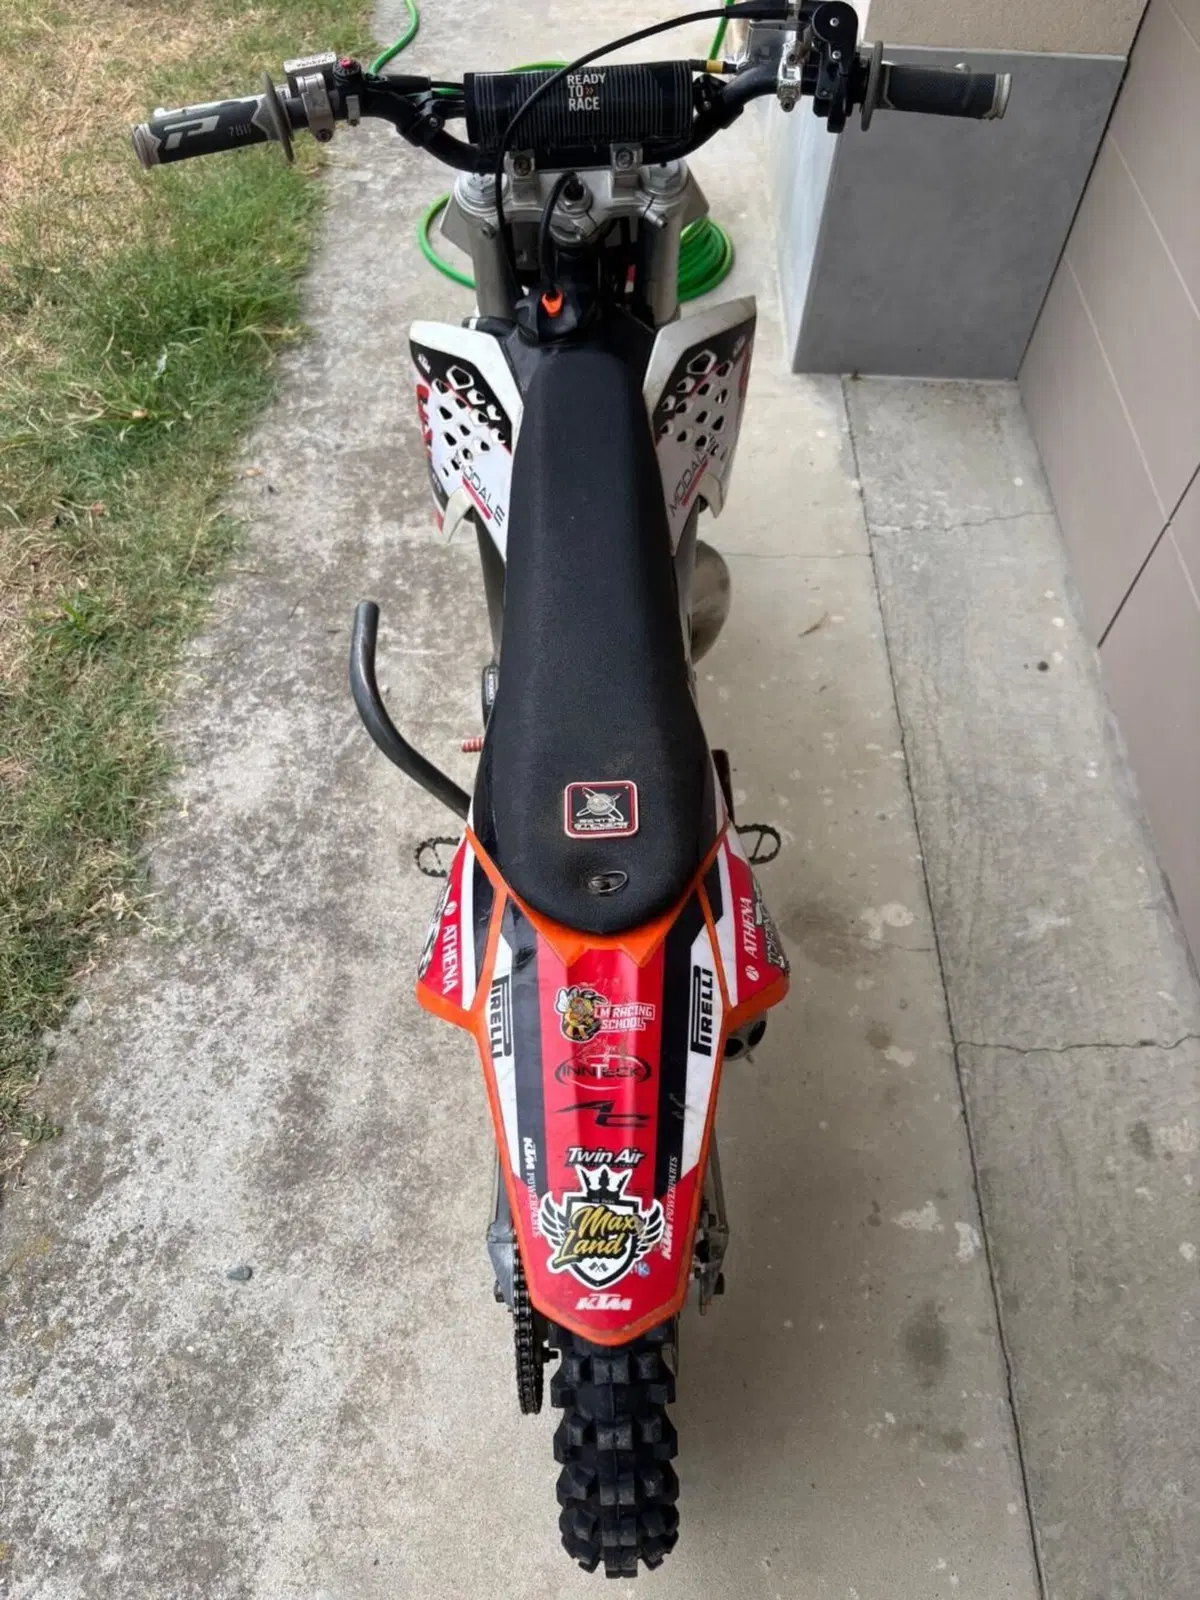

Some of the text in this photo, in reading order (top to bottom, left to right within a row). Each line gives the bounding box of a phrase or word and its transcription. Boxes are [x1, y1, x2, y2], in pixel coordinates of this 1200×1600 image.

[566, 72, 606, 86] READY
[568, 85, 584, 98] TO
[568, 96, 601, 112] RACE
[739, 896, 758, 959] ATHENA
[441, 924, 460, 995] ATHENA
[490, 973, 513, 1059] PIRELLI
[594, 1003, 653, 1018] LM RACING
[602, 1017, 644, 1030] SCHOOL
[690, 964, 713, 1057] PIRELLI
[522, 1137, 538, 1170] KTM
[566, 1146, 647, 1164] Twin Air
[664, 1155, 679, 1222] POWERPARTS
[570, 1205, 637, 1240] Max
[552, 1229, 628, 1268] Land
[575, 1293, 633, 1311] KTM
